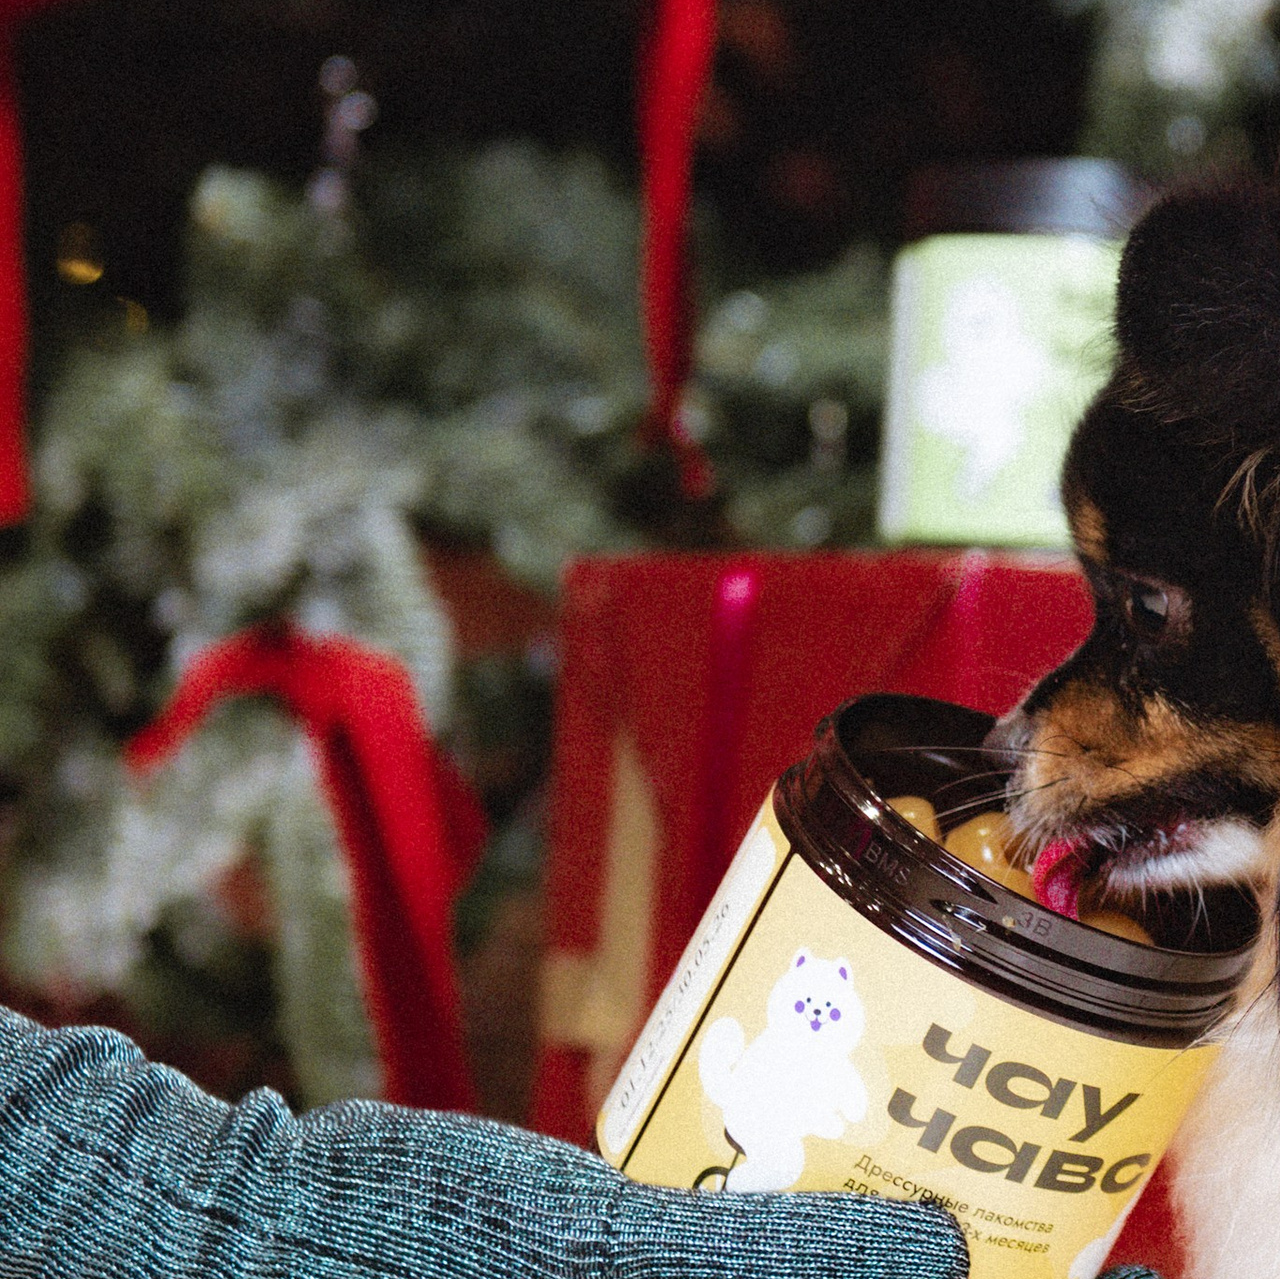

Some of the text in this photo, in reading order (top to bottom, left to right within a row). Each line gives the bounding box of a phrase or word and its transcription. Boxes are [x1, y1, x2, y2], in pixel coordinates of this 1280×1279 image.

[922, 1022, 1141, 1144] чау
[887, 1087, 1152, 1194] чавс
[853, 1154, 1055, 1234] Дрессурные лакомства
[985, 1236, 1051, 1254] месяцев
